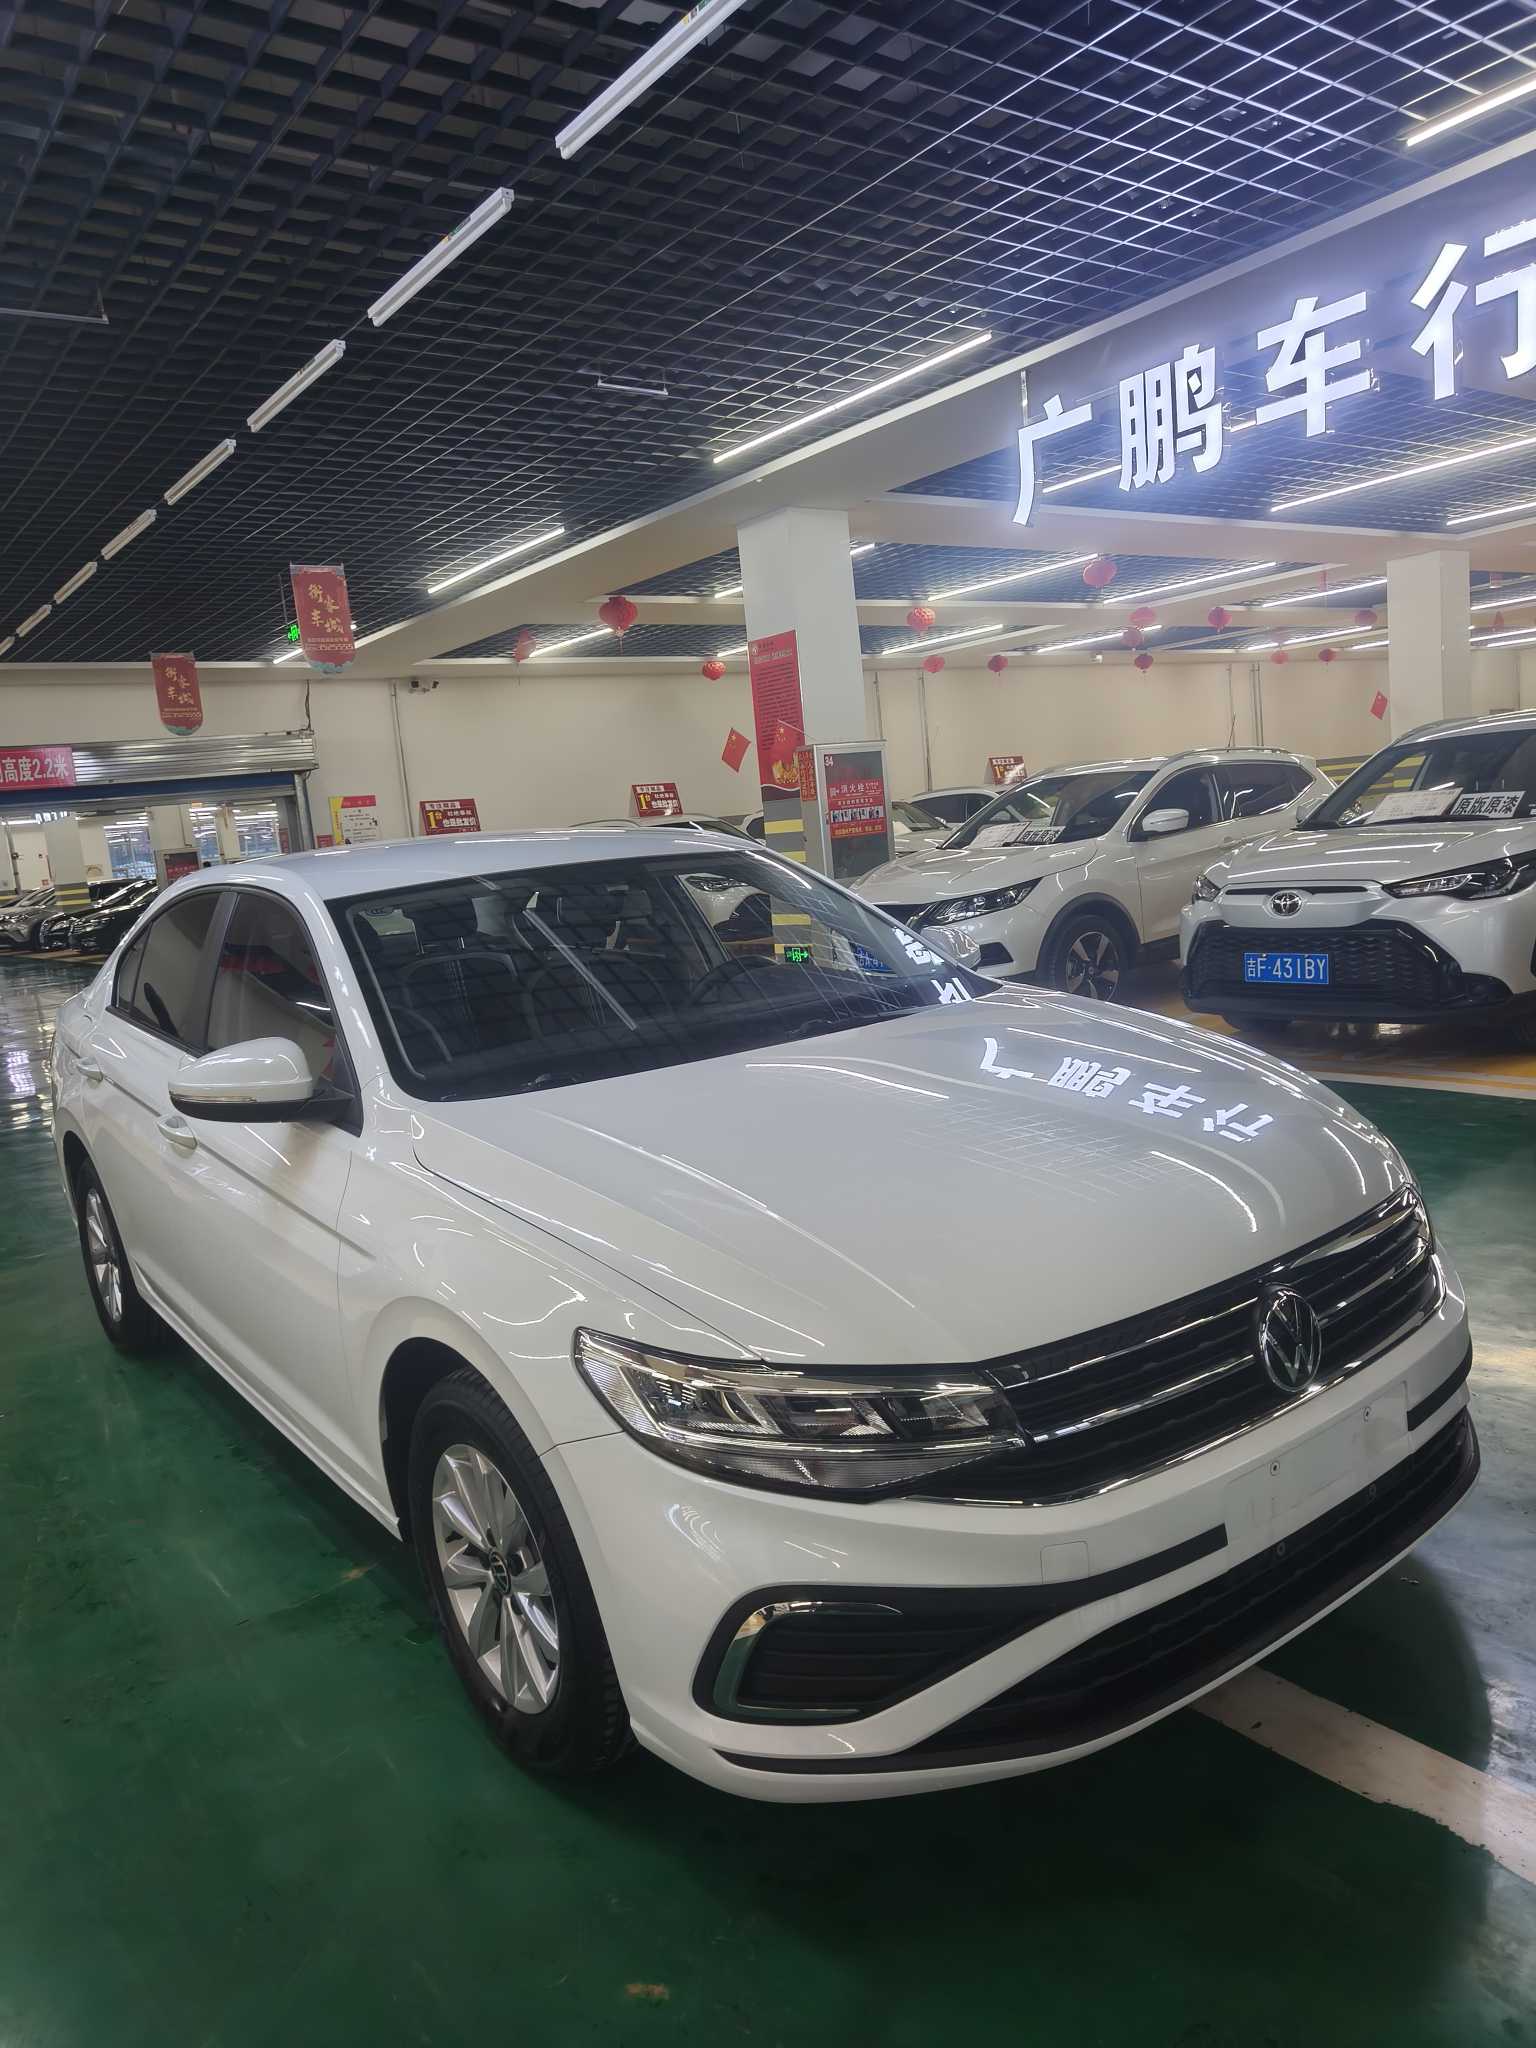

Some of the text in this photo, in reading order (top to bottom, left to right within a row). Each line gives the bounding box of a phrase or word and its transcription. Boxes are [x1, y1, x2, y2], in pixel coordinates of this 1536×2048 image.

[1013, 217, 1536, 526] 广鹏车行
[0, 754, 69, 782] 高度2.2米
[1453, 796, 1519, 814] 原版原漆
